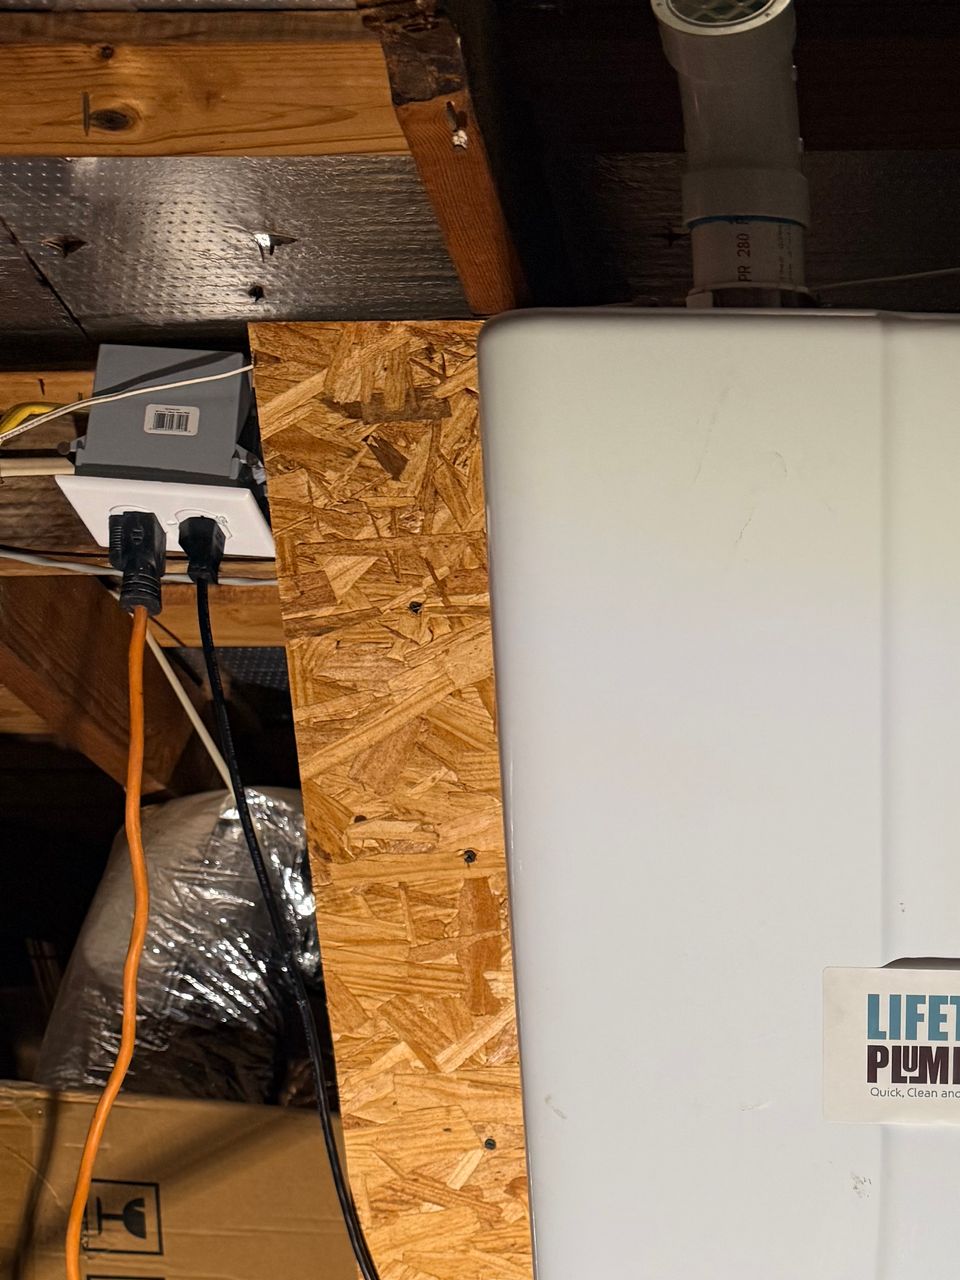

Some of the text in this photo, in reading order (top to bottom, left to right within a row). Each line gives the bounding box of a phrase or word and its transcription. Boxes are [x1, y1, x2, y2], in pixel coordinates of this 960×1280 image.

[737, 233, 750, 256] 280
[870, 1087, 905, 1099] Quick,
[907, 1087, 938, 1099] Clean
